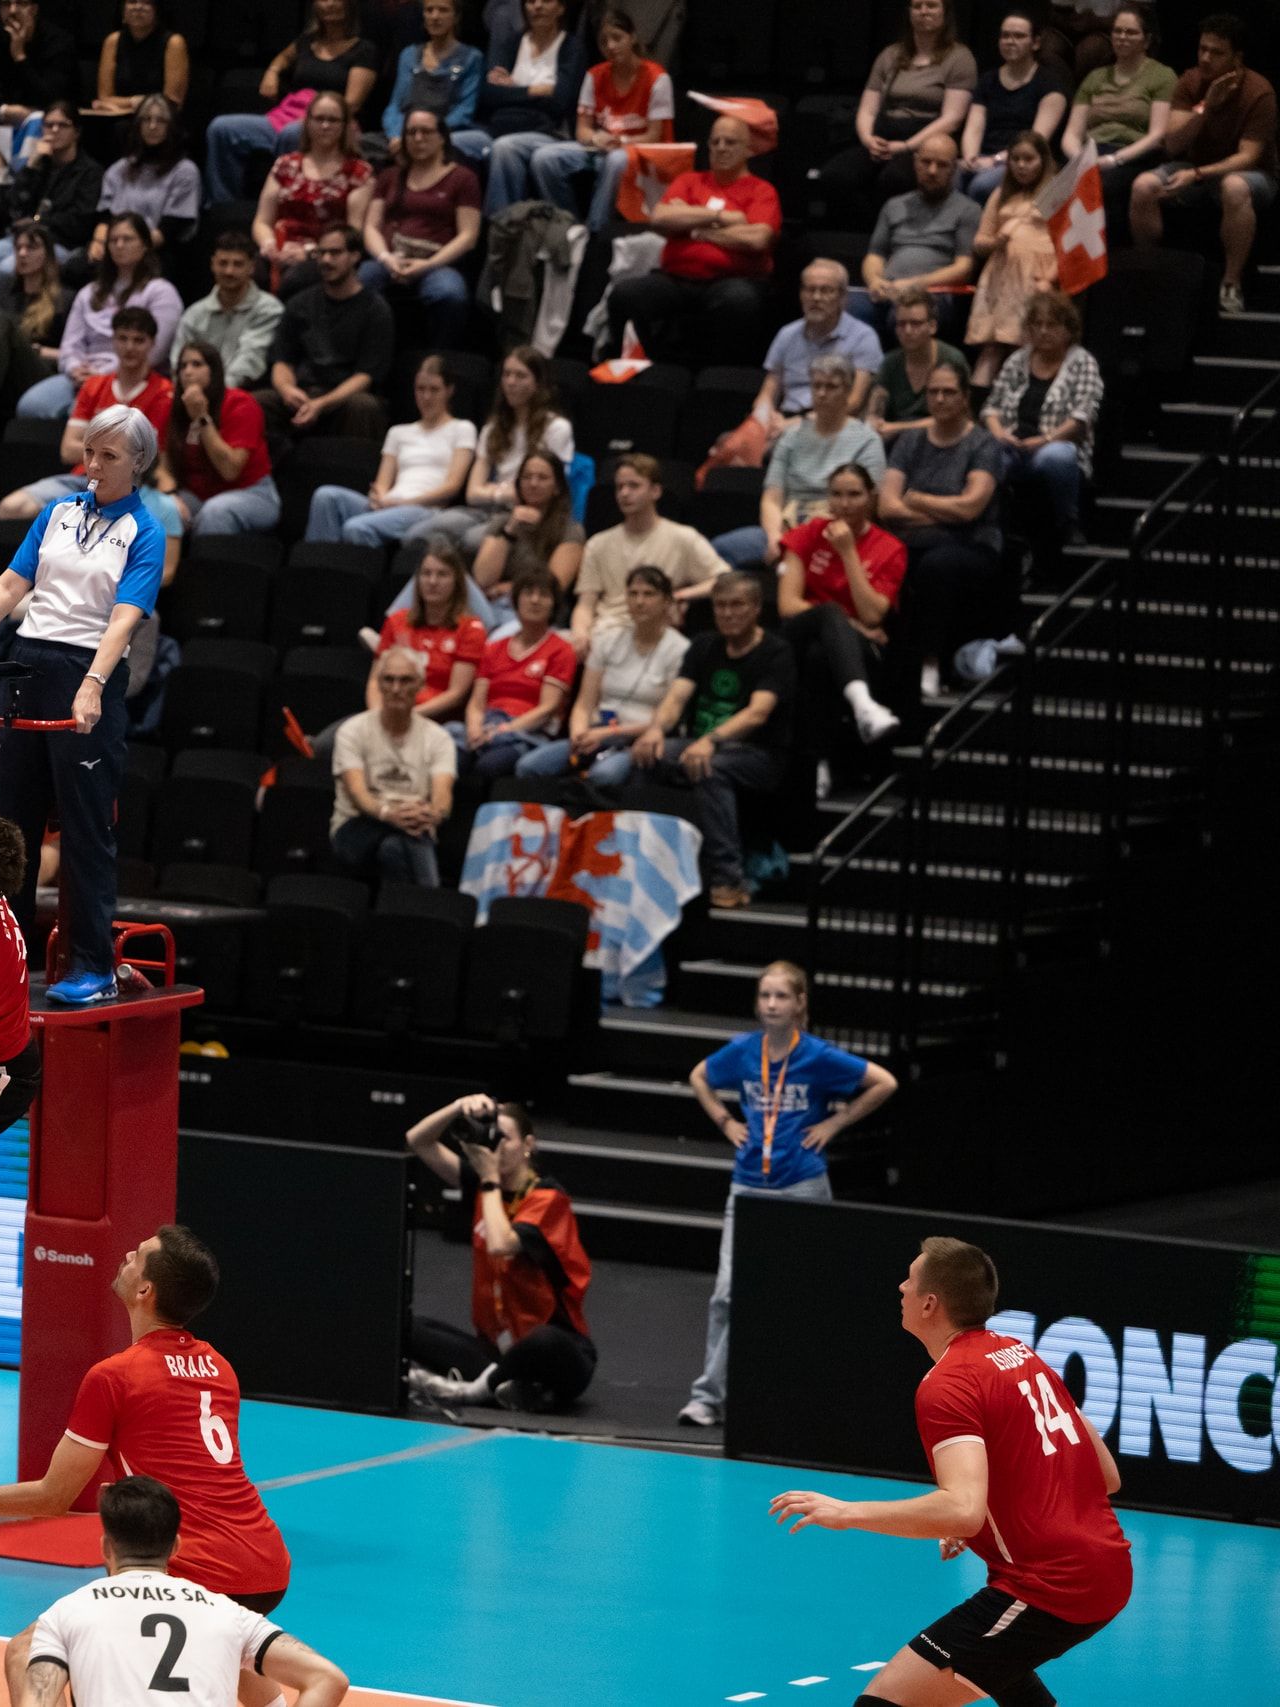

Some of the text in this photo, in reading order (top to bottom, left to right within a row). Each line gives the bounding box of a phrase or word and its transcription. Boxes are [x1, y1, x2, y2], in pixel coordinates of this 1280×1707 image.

[47, 1250, 94, 1267] Senoh
[164, 1354, 219, 1378] BRAAS
[199, 1390, 234, 1465] 6
[1017, 1372, 1080, 1457] 14
[92, 1586, 215, 1607] NOVAIS SA.
[140, 1613, 190, 1692] 2
